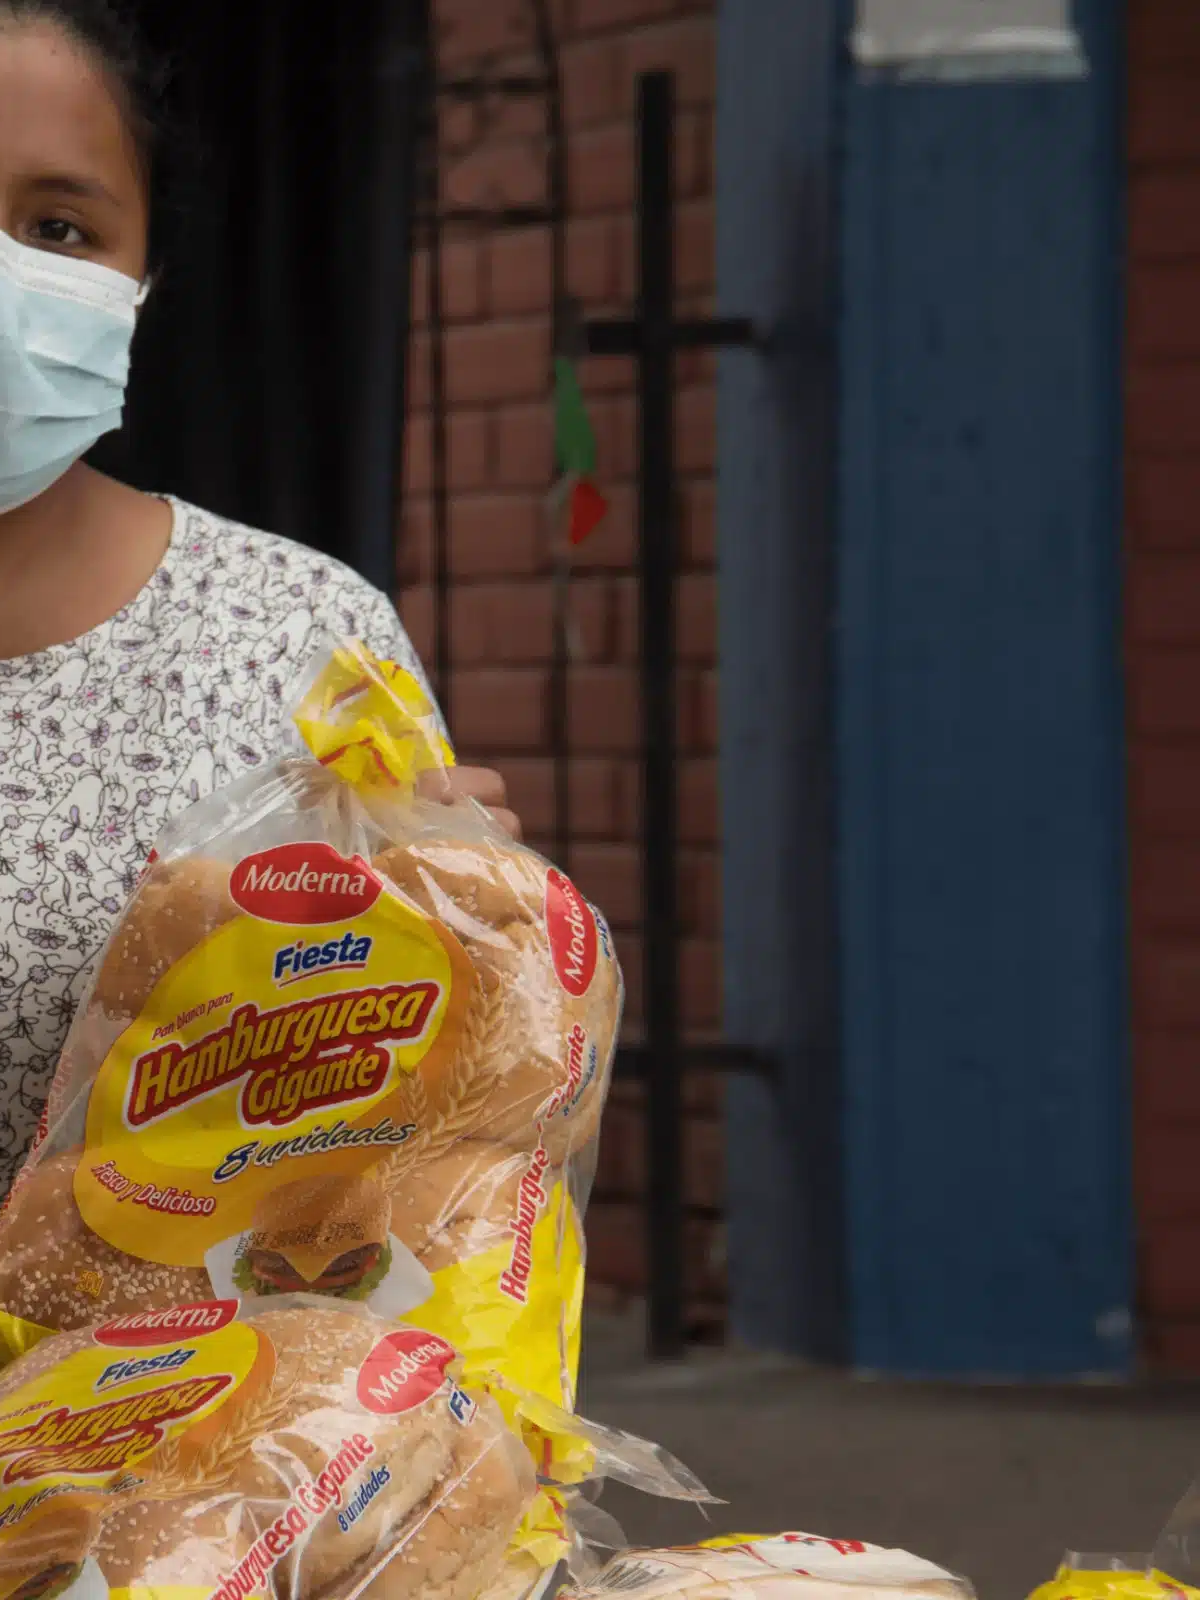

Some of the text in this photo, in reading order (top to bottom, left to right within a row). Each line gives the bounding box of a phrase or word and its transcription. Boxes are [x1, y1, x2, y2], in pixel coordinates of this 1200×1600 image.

[240, 861, 369, 897] Moderna
[274, 931, 373, 981] Fiesta
[151, 991, 235, 1041] Pan blanco para
[134, 988, 430, 1116] Hamburguesa
[248, 1044, 381, 1118] Gigante
[211, 1117, 417, 1183] 8 unidades
[91, 1160, 217, 1216] Fresco y Delicioso
[500, 1147, 550, 1304] Hamburgue
[111, 1305, 223, 1331] Moderna
[96, 1348, 197, 1387] Fiesta
[367, 1339, 447, 1406] Moderna
[210, 1432, 374, 1600] burguesa Gigante
[337, 1466, 391, 1533] 8 unidades
